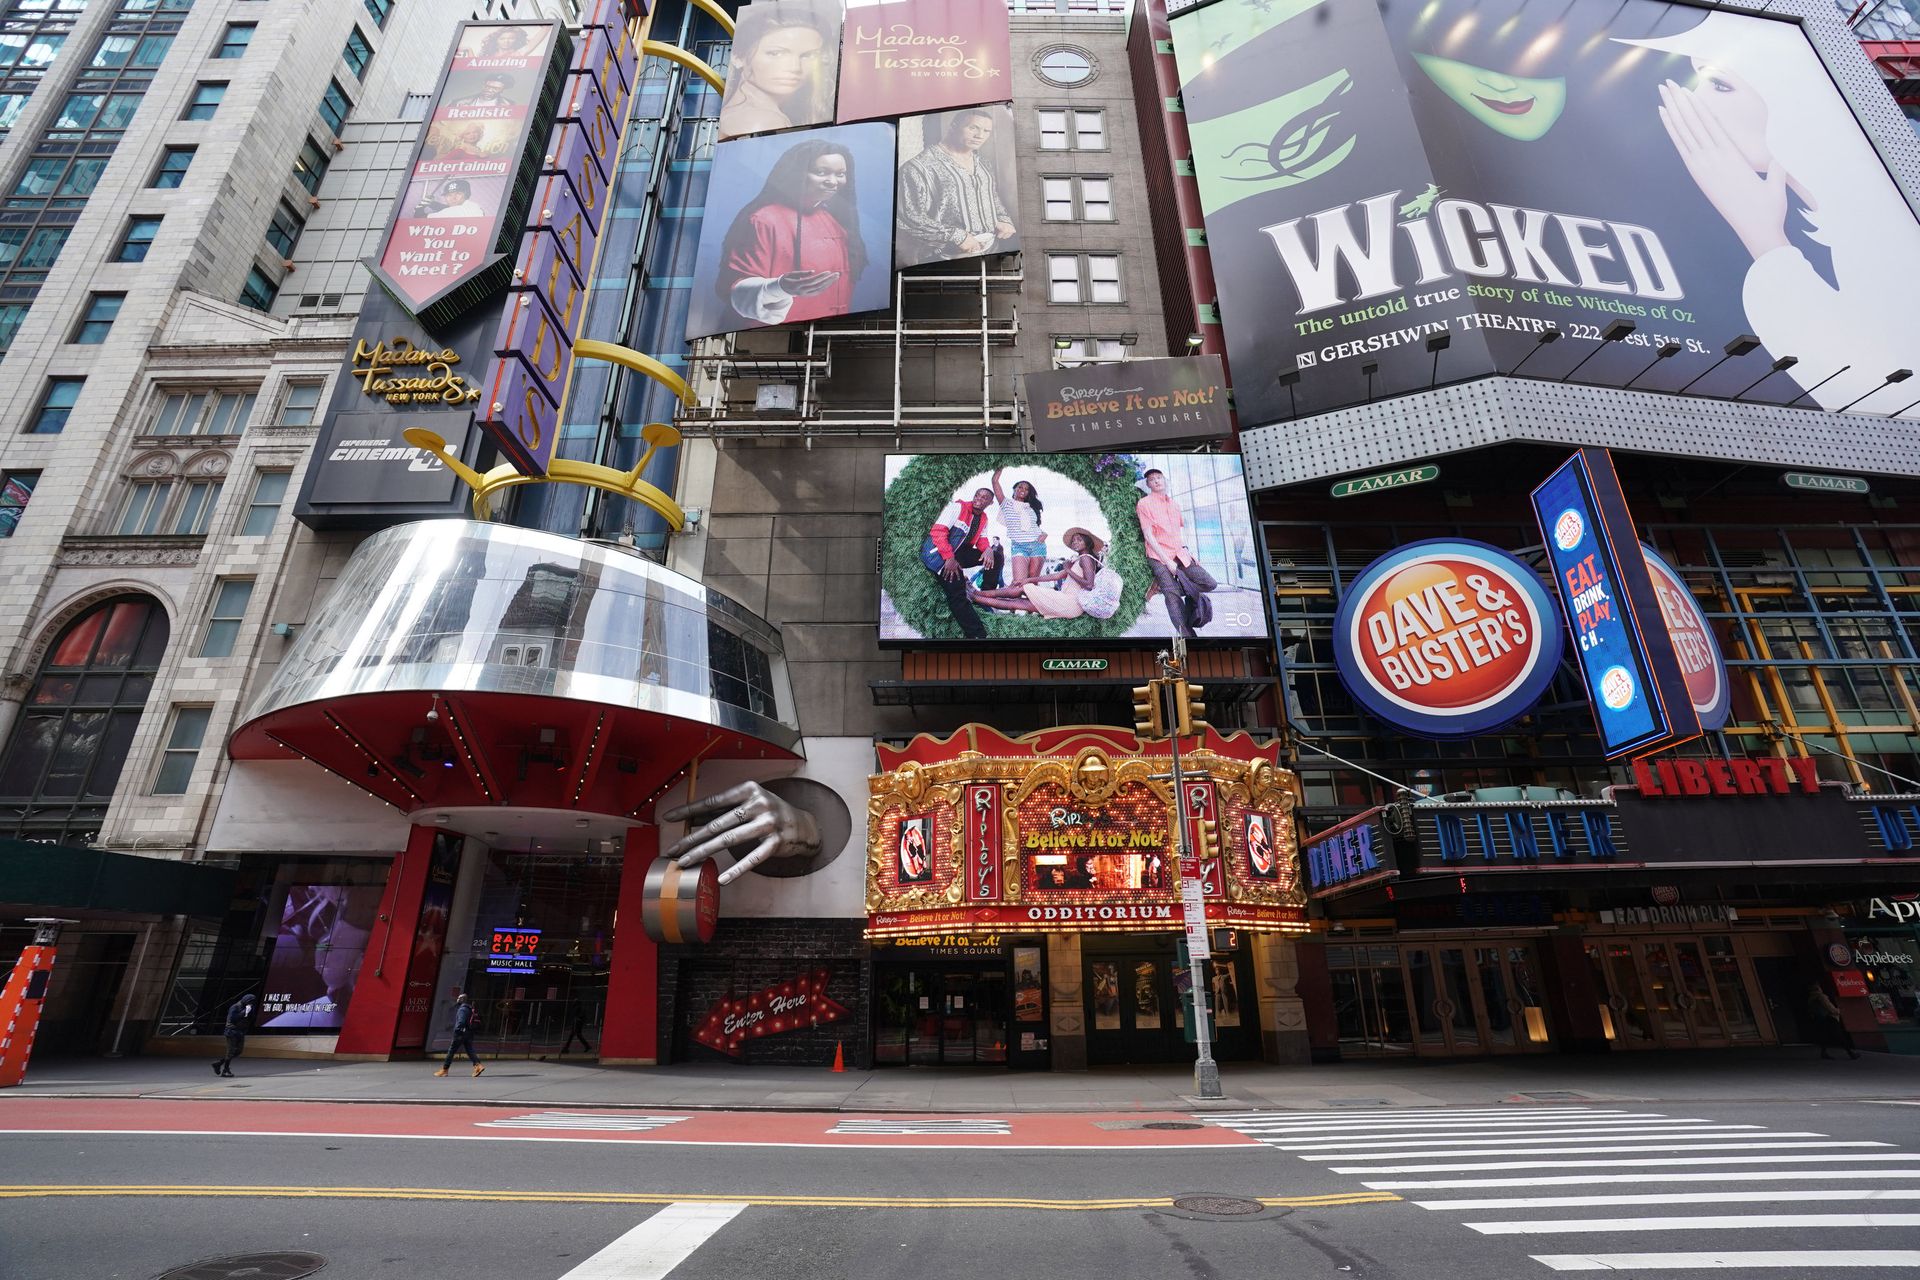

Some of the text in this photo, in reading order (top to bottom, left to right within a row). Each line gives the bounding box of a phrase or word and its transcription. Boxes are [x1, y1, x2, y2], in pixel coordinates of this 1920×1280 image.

[855, 24, 968, 48] Madame
[467, 57, 528, 68] Amazing
[856, 46, 985, 79] Tussauds
[448, 107, 512, 119] Realistic
[419, 160, 507, 173] Entertaining
[408, 224, 478, 237] Who Do
[424, 238, 455, 249] You
[400, 251, 470, 262] Want to
[1295, 284, 1696, 337] The untold true story of the Witches of Oz
[1321, 320, 1449, 362] GERSHWIN
[1569, 323, 1603, 341] 222
[1613, 333, 1651, 347] est
[1686, 338, 1711, 354] St.
[352, 336, 461, 368] Madame
[351, 362, 465, 405] Tussauds
[385, 392, 440, 403] NEW YORK
[1047, 386, 1215, 419] Believe It or Not!
[1070, 411, 1202, 433] TIMES SQUARE
[338, 439, 391, 447] EXPERIENCE
[329, 448, 421, 461] CINEMA
[1347, 469, 1423, 494] LAMAR
[1798, 476, 1857, 490] LAMAR
[1565, 553, 1603, 598] EAT.
[1573, 582, 1610, 614] DRINK.
[1367, 574, 1513, 656] DAVE &
[1671, 590, 1698, 629] &
[1380, 609, 1527, 691] BUSTER'S
[1672, 631, 1712, 674] TER'S
[1048, 660, 1101, 669] LAMAR
[1632, 757, 1820, 797] LIBERTY
[1026, 829, 1164, 848] Believe It or Not!
[1434, 811, 1617, 860] DINER
[1307, 824, 1379, 888] DINER
[910, 914, 933, 923] Believe
[935, 912, 941, 921] It
[1028, 905, 1172, 919] ODDITORIUM
[1256, 909, 1275, 918] Believe
[1614, 905, 1730, 925] EAT DRINK PLAY
[493, 933, 539, 945] RADIO
[943, 935, 955, 946] It
[1230, 931, 1236, 946] 2
[492, 944, 536, 954] CITY
[268, 993, 280, 1001] WAS
[281, 993, 291, 1002] LIKE
[285, 1003, 300, 1012] WHAT
[724, 993, 807, 1035] Enter Here
